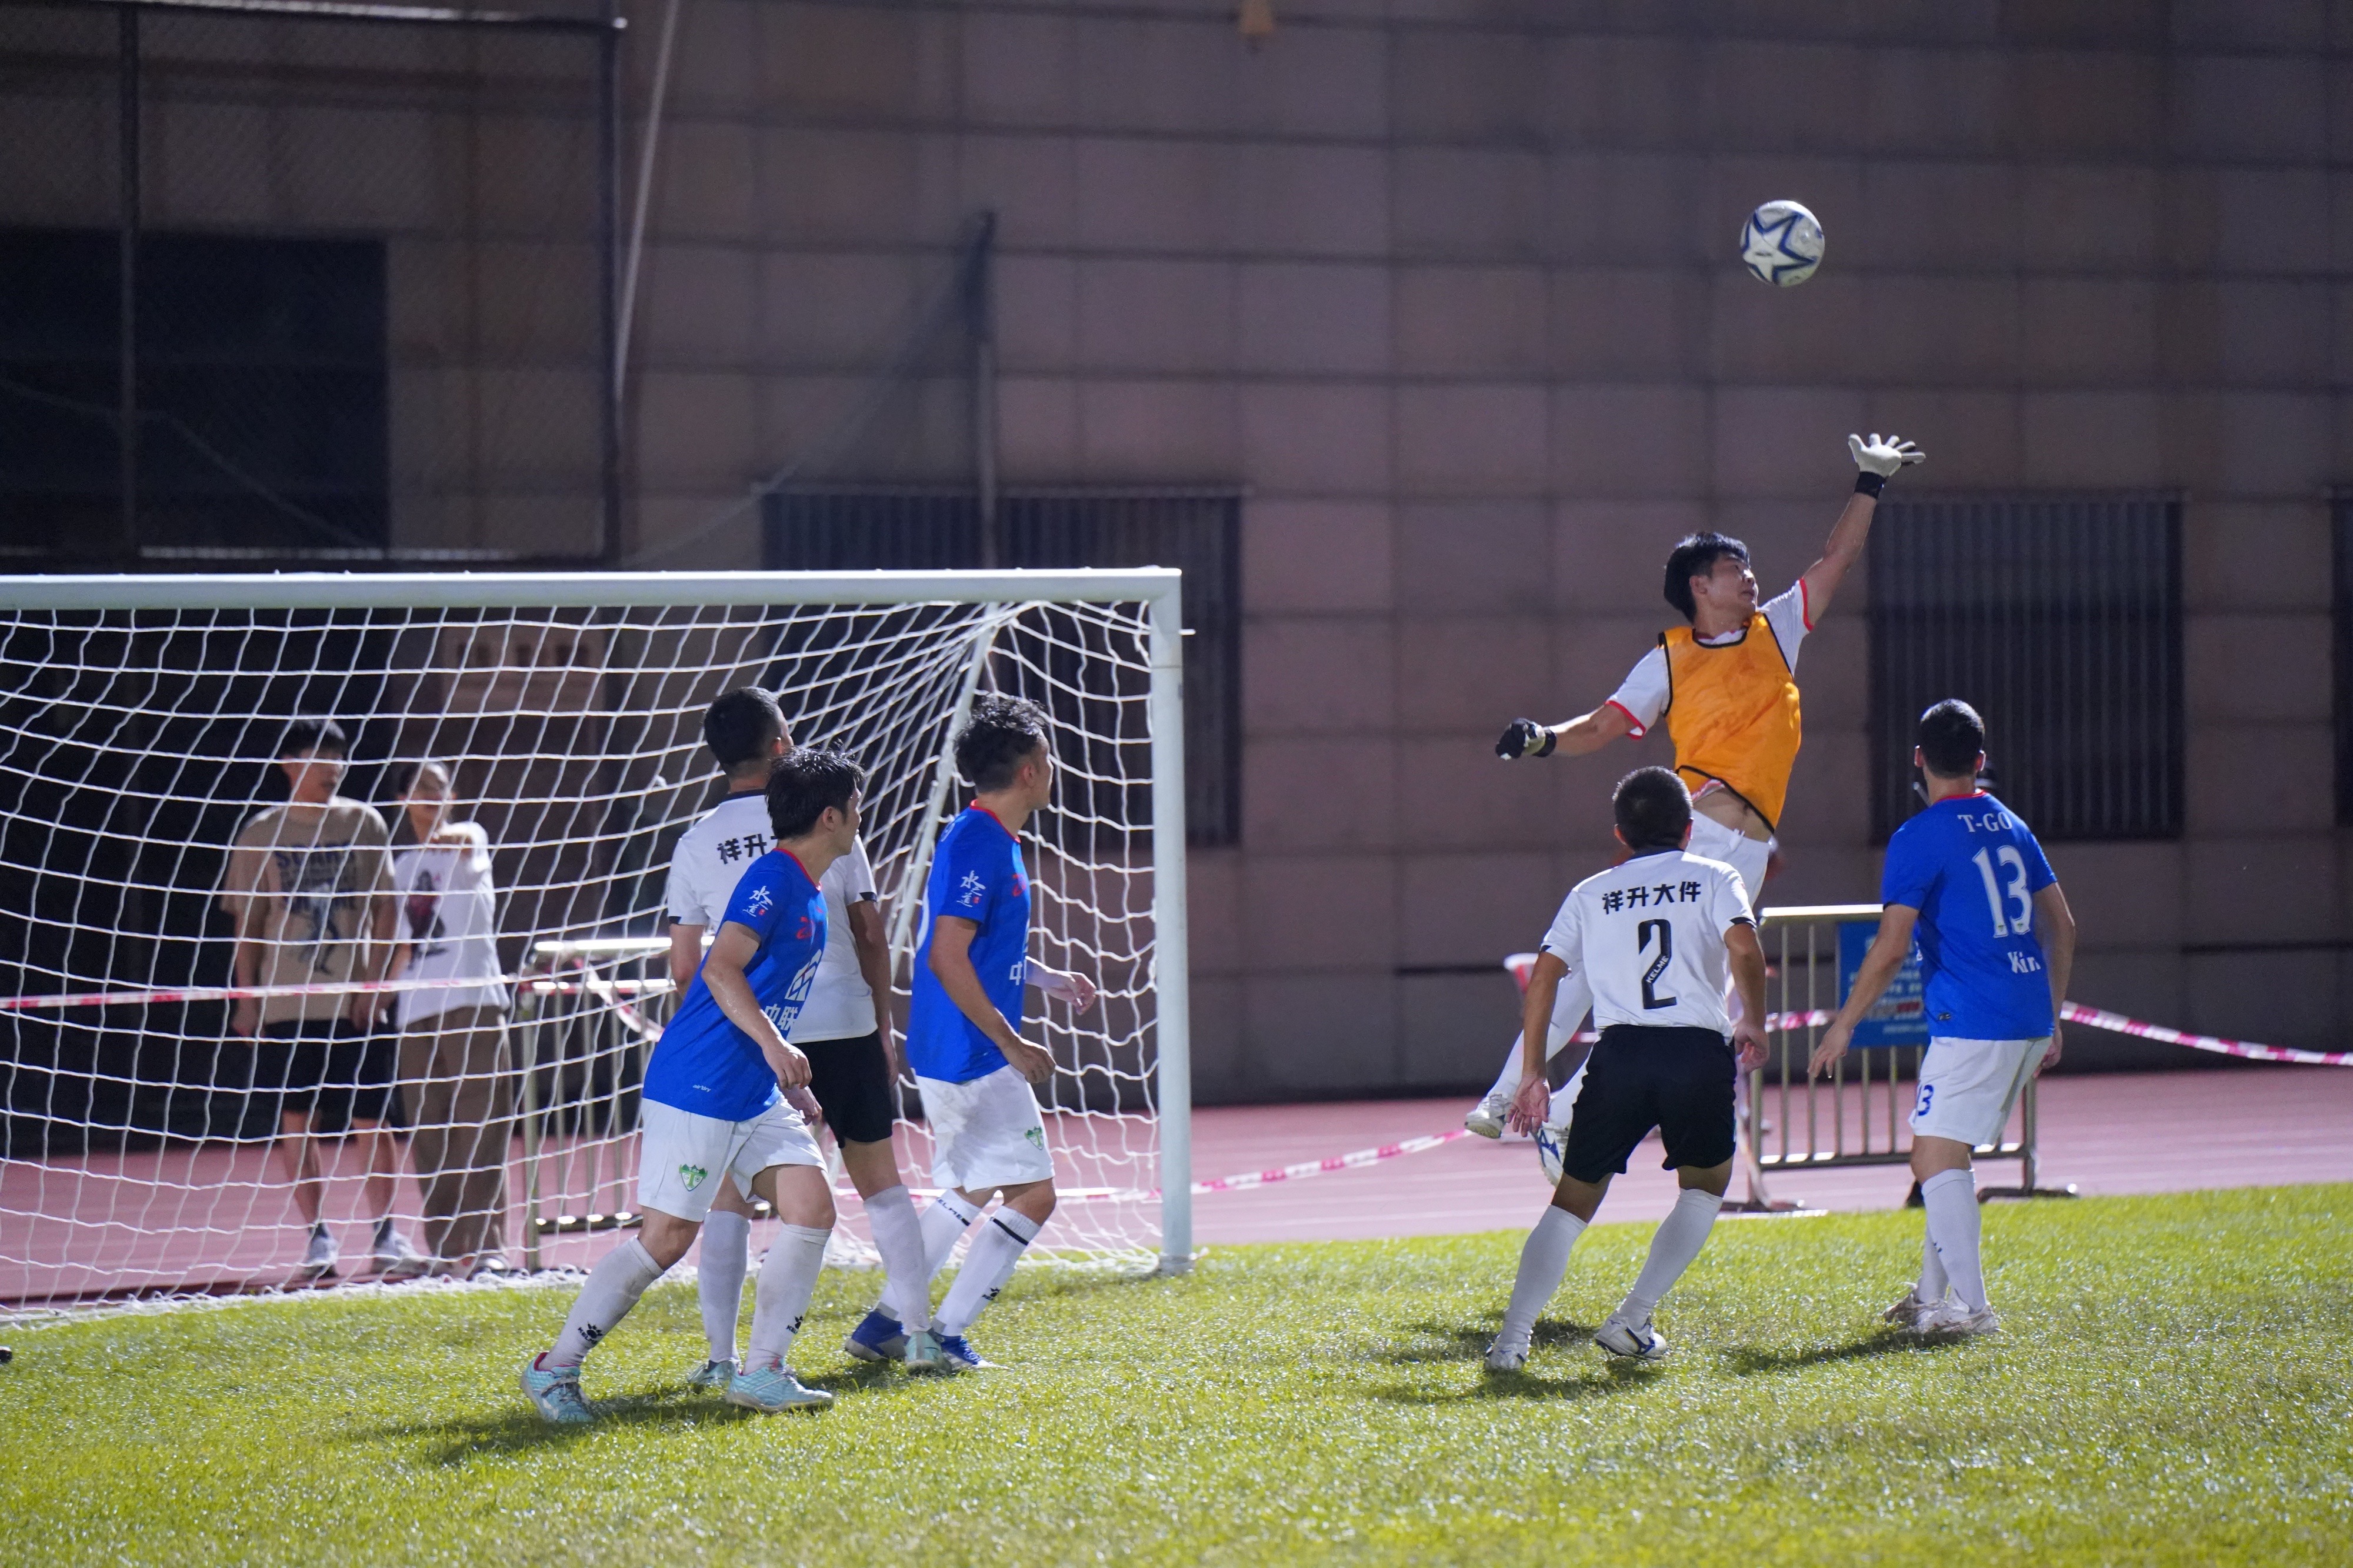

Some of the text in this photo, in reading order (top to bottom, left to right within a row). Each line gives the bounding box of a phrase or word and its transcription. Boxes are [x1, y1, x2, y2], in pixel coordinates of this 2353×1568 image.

[1957, 812, 2012, 832] T-GO
[716, 833, 778, 865] 祥升
[1602, 881, 1702, 915] 祥升大件
[1972, 845, 2032, 938] 13
[1638, 919, 1677, 1009] 2
[1646, 956, 1669, 983] KELME
